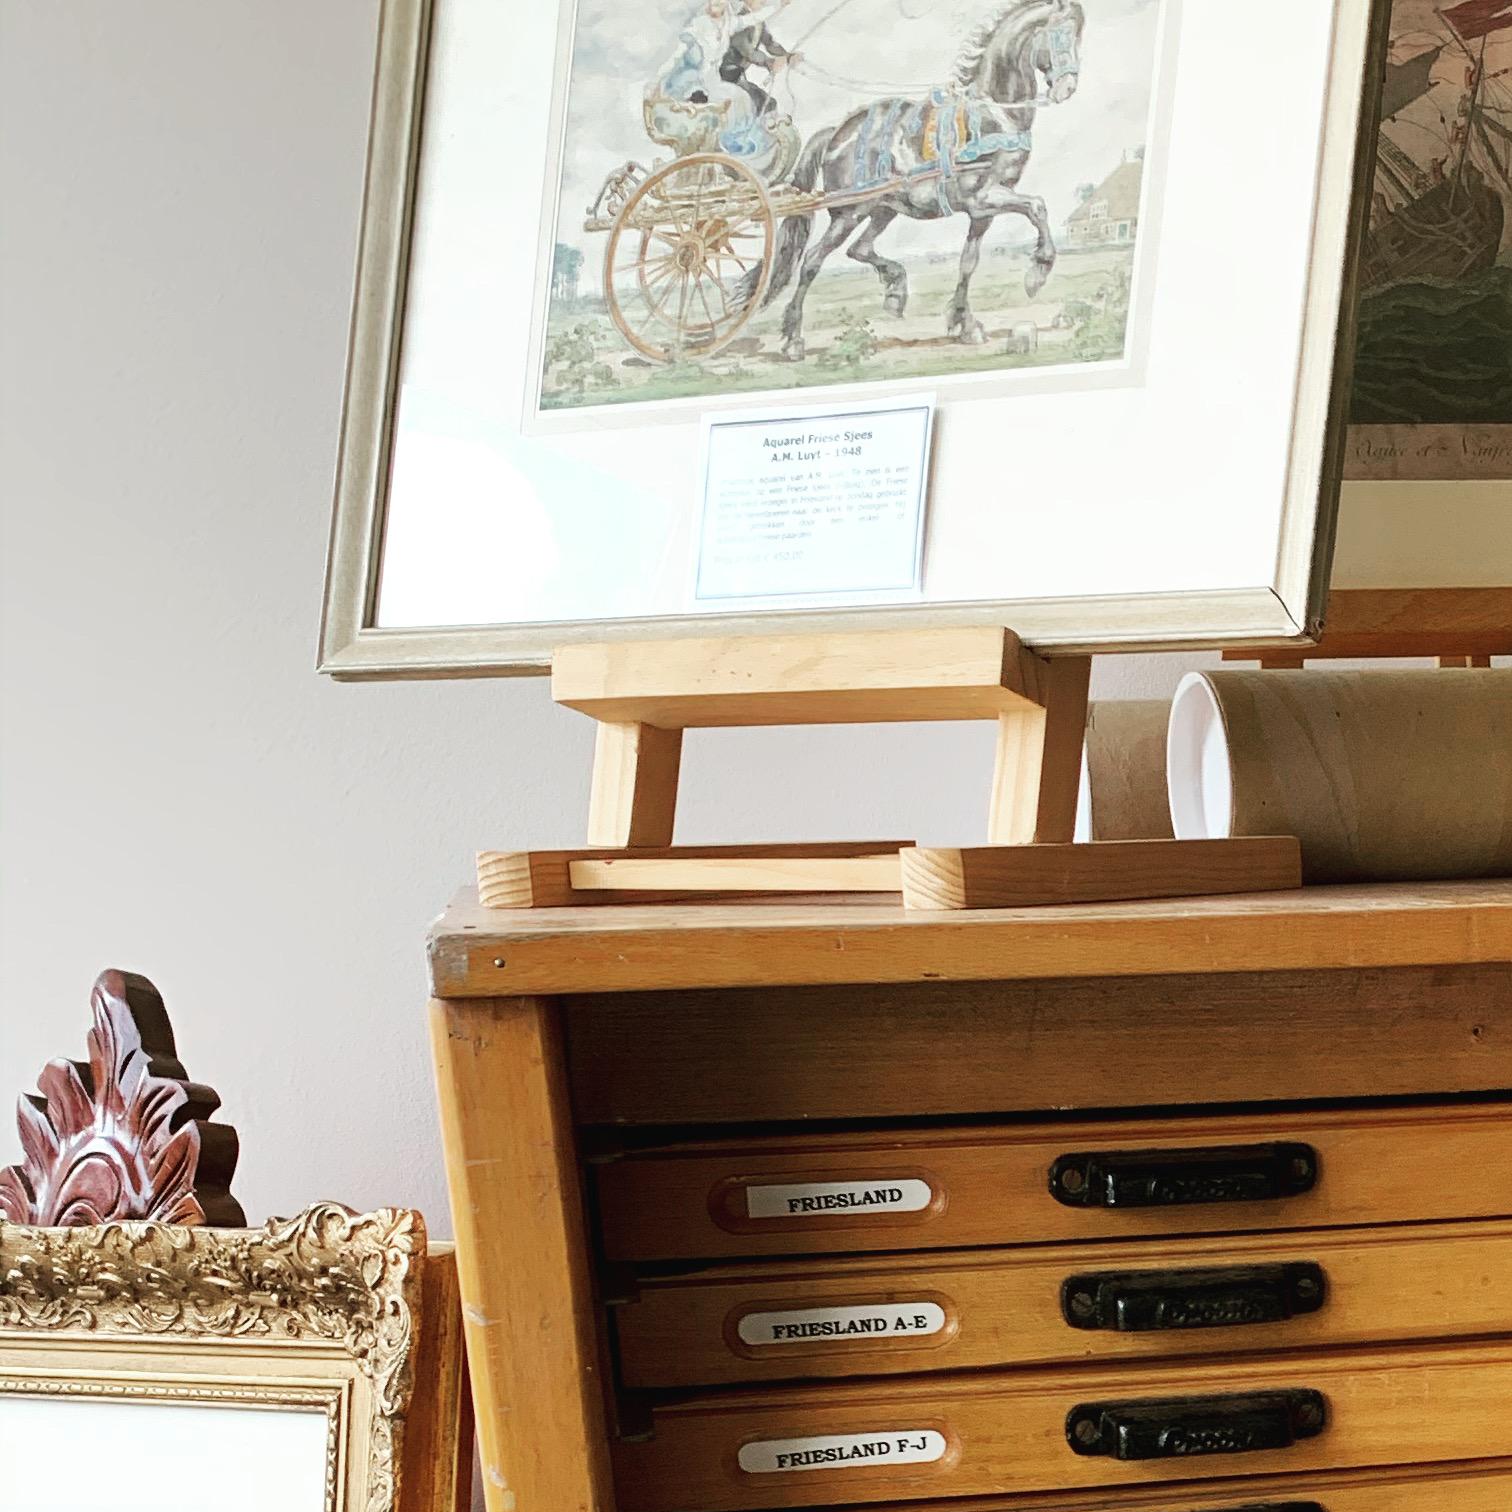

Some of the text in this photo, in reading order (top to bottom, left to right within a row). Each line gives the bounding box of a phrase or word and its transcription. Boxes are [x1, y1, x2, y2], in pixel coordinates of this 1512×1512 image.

[763, 431, 873, 448] Aquarel Friese Sjees
[835, 446, 862, 457] 1948
[788, 1187, 903, 1213] FRIESLAND
[772, 1314, 928, 1339] FRIESLAND A-E
[775, 1437, 928, 1469] FRIESLAND F-J
